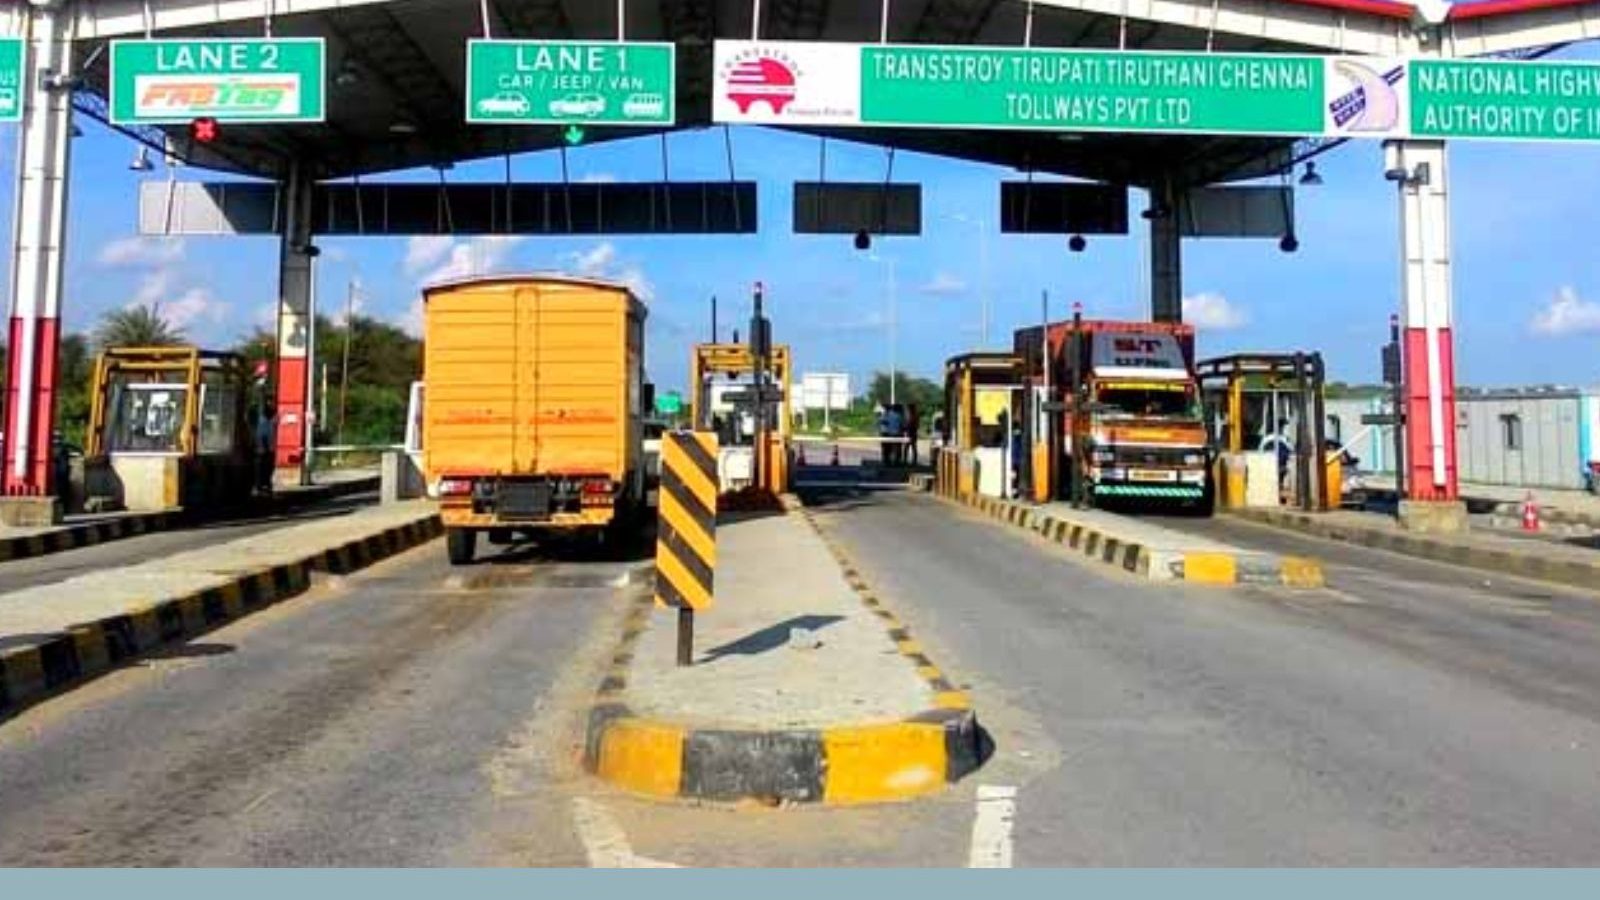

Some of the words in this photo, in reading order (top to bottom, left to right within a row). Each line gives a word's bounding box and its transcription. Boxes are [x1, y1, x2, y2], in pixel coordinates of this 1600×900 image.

[157, 45, 248, 70] LANE
[260, 44, 279, 69] 2
[516, 46, 605, 72] LANE
[617, 46, 627, 72] 1
[498, 75, 533, 89] CAR
[552, 75, 592, 89] JEEP
[609, 77, 643, 89] VAN
[873, 54, 1004, 82] TRANSSTROY
[1011, 57, 1099, 84] TIRUPATI
[1107, 59, 1214, 87] TIRUTHANI
[1219, 61, 1313, 90] CHENNAI
[1417, 67, 1530, 95] NATIONAL
[1006, 93, 1108, 121] TOLLWAYS
[1114, 96, 1149, 121] PVT
[1155, 98, 1191, 123] LTD
[1424, 106, 1547, 134] AUTHORITY
[1553, 105, 1582, 133] OF
